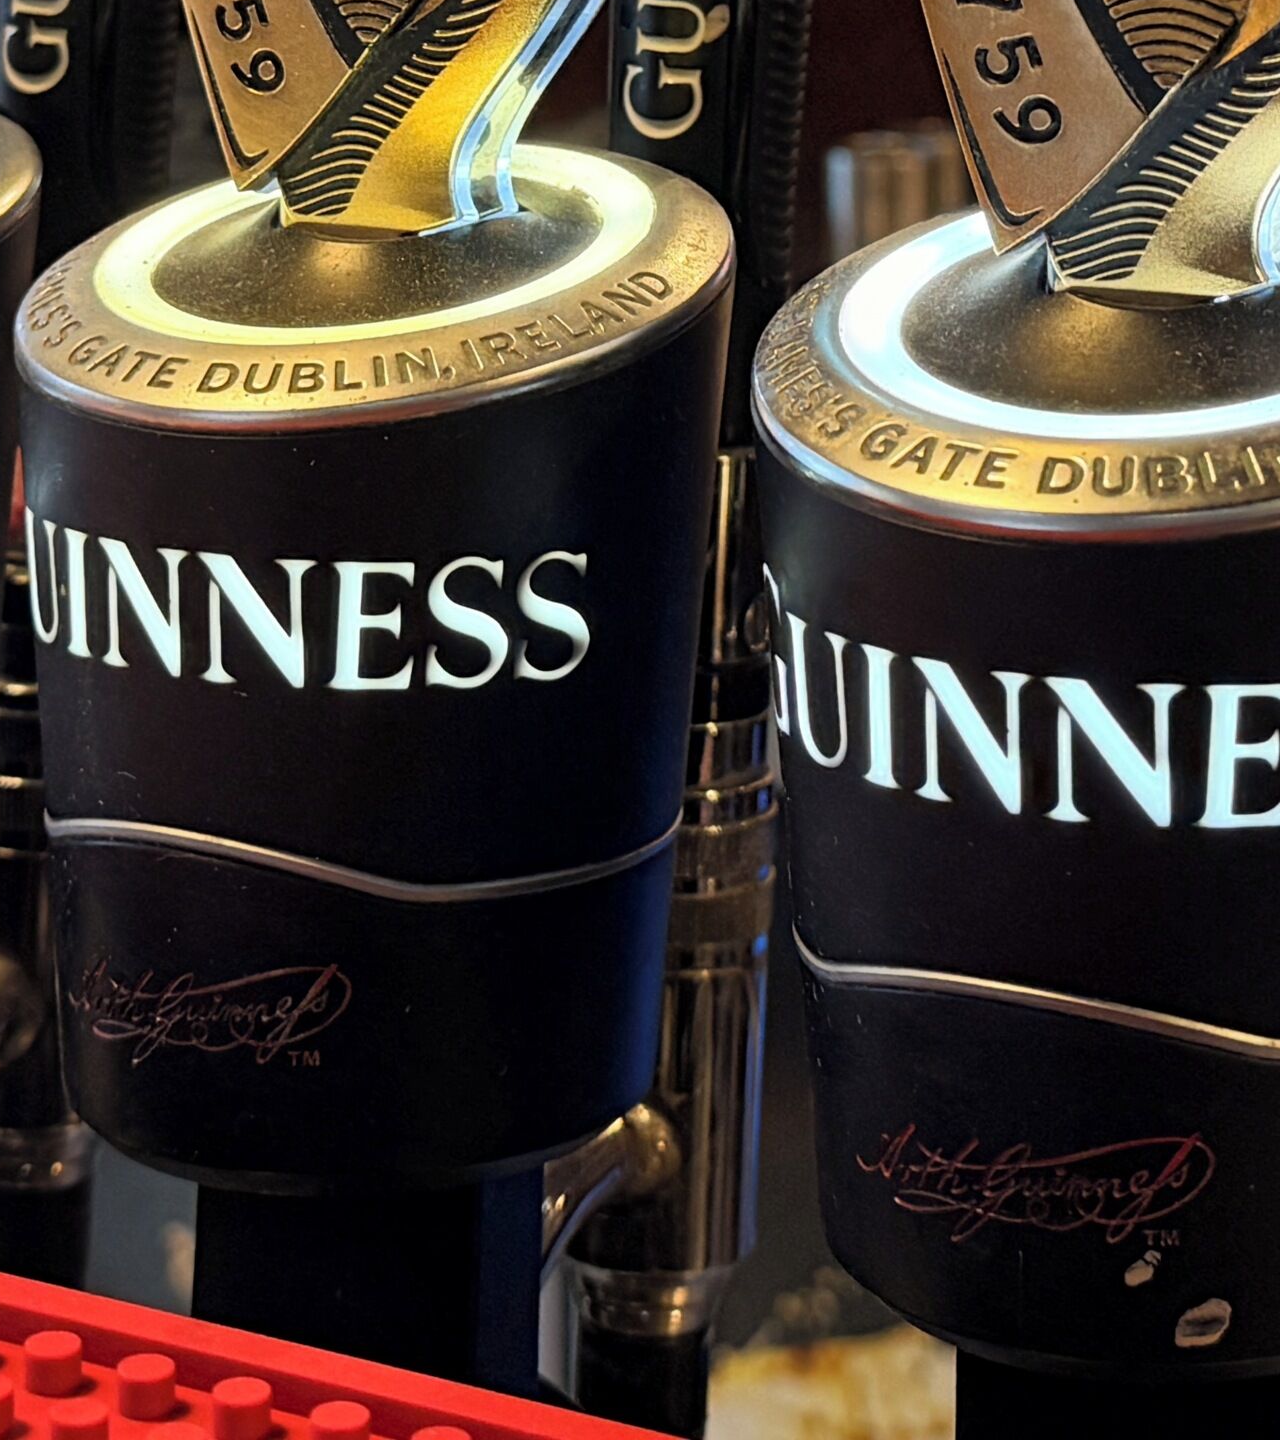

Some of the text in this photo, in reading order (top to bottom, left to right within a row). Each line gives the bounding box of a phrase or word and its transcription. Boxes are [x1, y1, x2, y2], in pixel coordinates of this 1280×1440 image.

[67, 334, 190, 390] GATE
[460, 270, 674, 373] IRELAND
[860, 420, 1019, 490] GATE
